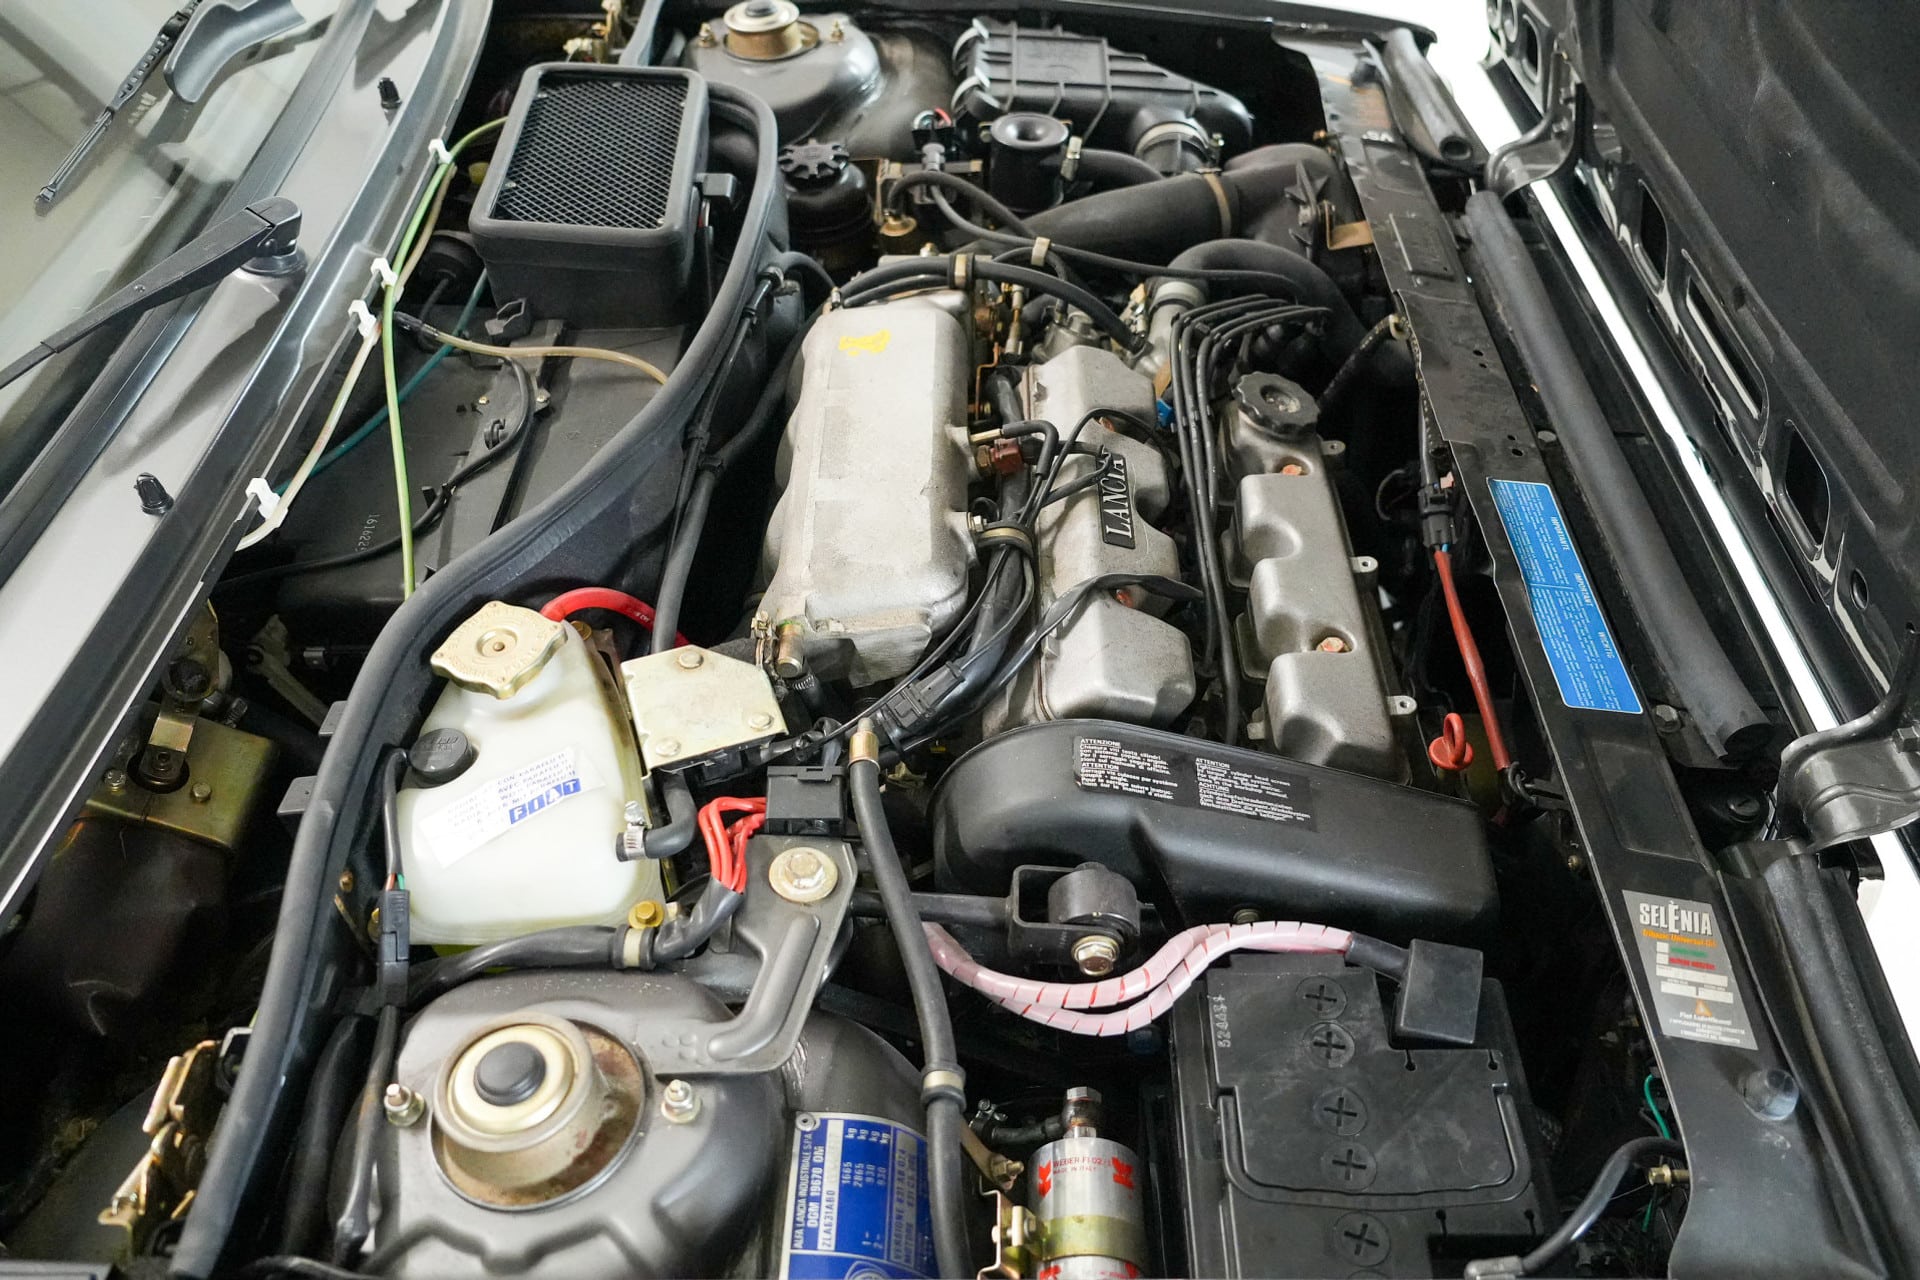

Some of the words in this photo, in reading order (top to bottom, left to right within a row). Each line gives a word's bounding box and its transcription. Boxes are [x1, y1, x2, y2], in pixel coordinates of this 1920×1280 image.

[1101, 459, 1131, 538] LANCIA
[1551, 516, 1569, 551] IMPORTANTE
[1574, 572, 1593, 607] IMPORTANT
[1598, 631, 1615, 659] WICHTIG
[1080, 738, 1121, 747] ATTENZIONE
[1082, 762, 1119, 770] ATTENTION
[1196, 758, 1230, 768] ATTENTION
[1199, 782, 1229, 791] ACHTUNG
[508, 778, 582, 825] FIAT
[845, 1128, 857, 1138] kg
[857, 1129, 868, 1140] kg
[869, 1131, 879, 1142] kg
[880, 1133, 890, 1144] kg
[799, 1152, 810, 1196] INDUSTRIALE
[808, 1202, 820, 1227] DGM
[814, 1146, 824, 1162] OM
[796, 1198, 806, 1227] LANCIA
[794, 1229, 804, 1248] ALFA
